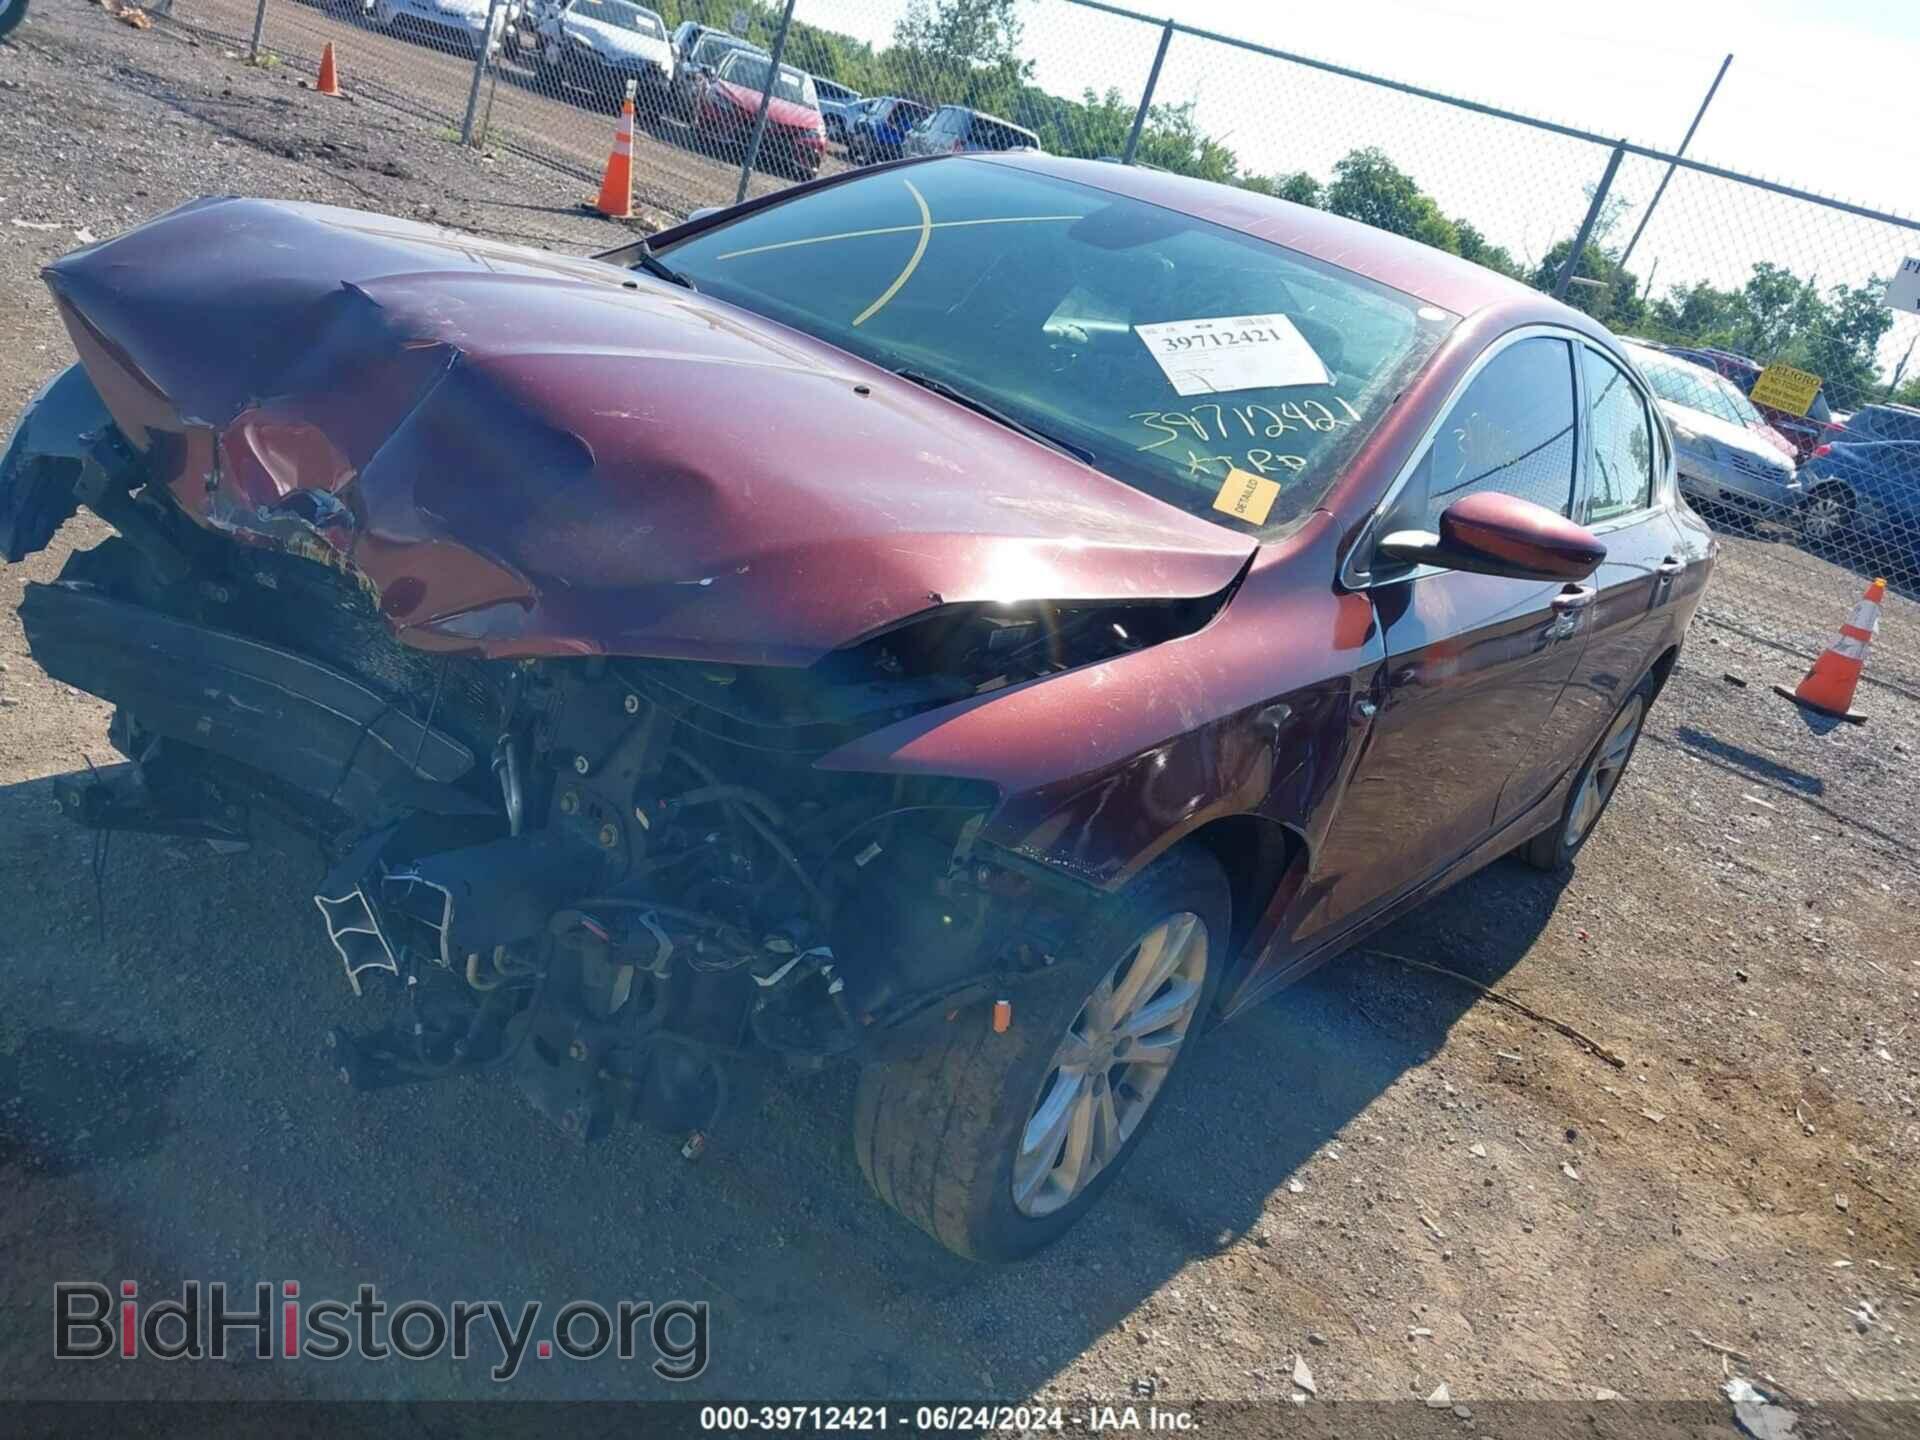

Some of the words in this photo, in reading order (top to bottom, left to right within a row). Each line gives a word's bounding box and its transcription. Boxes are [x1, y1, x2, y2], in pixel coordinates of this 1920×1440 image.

[1161, 328, 1283, 352] 39712421
[1129, 396, 1362, 451] 39712421
[1234, 478, 1258, 514] DETAILED
